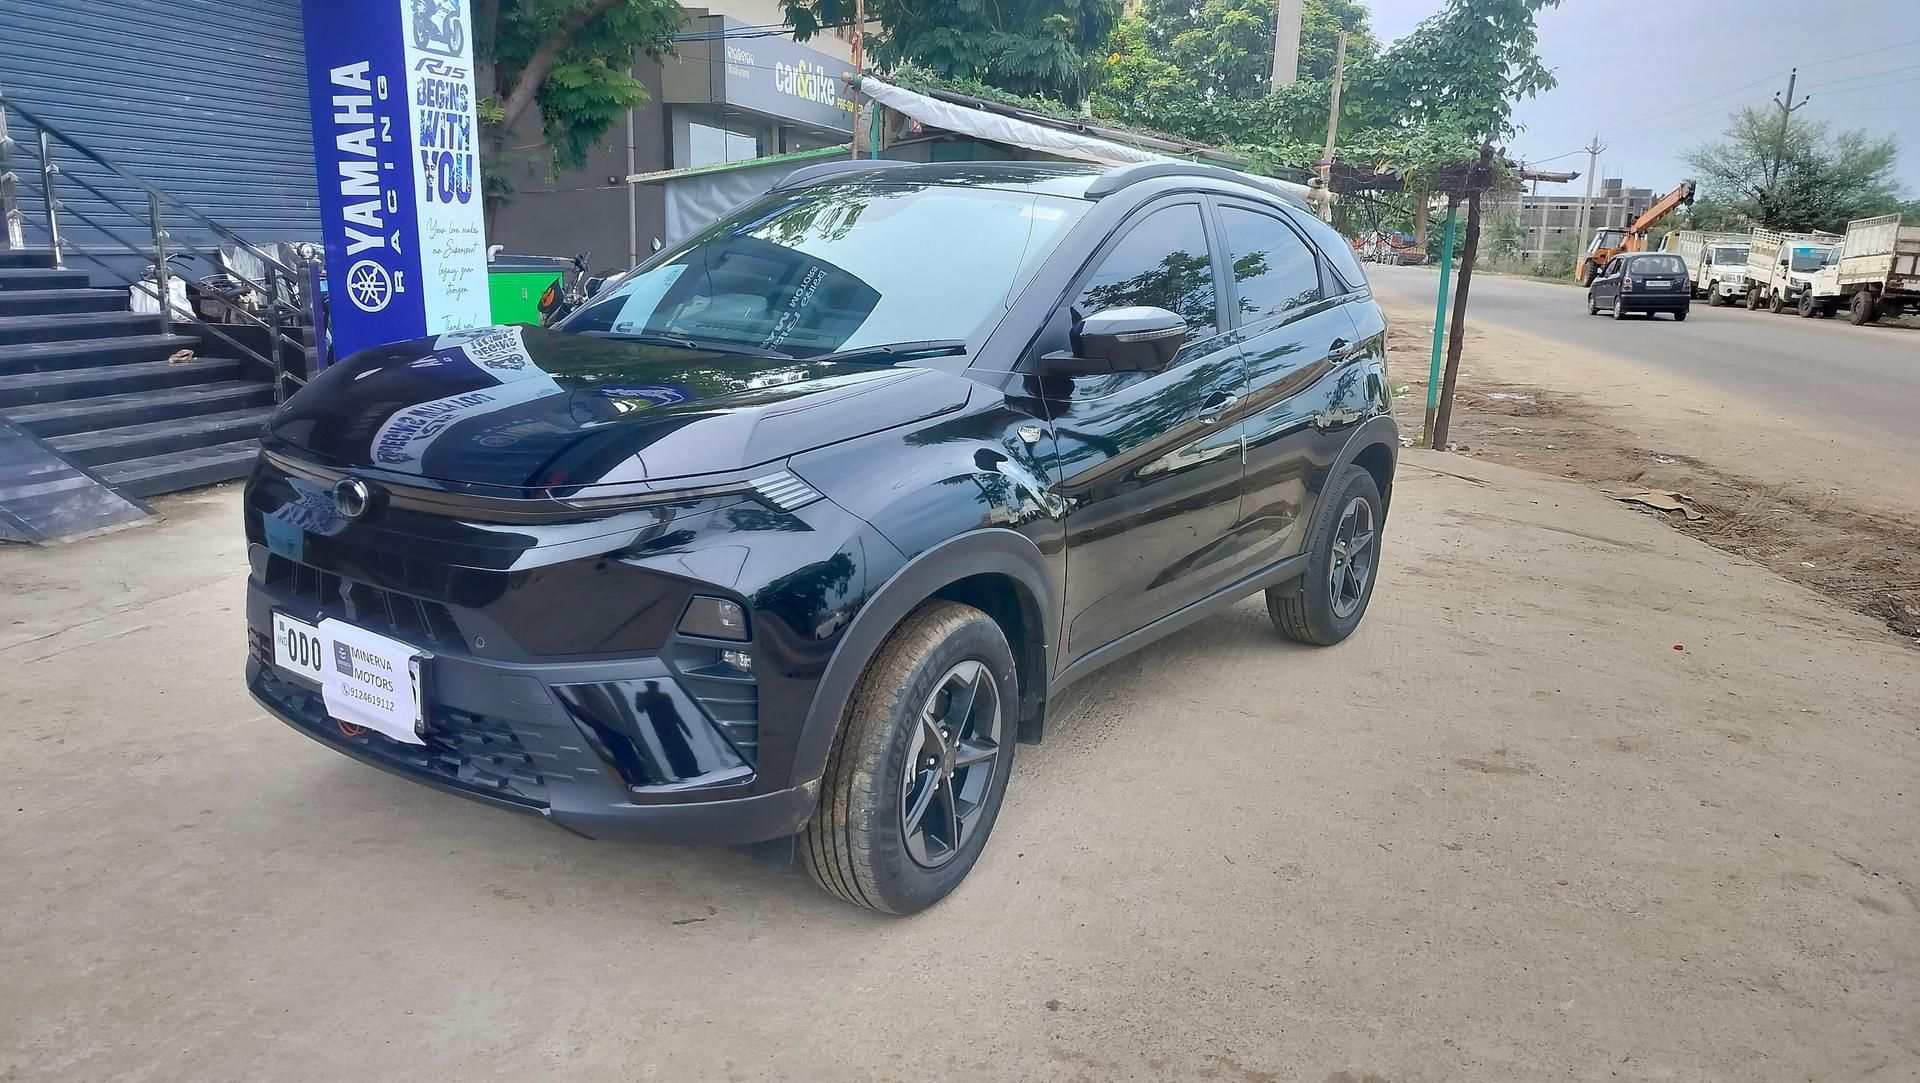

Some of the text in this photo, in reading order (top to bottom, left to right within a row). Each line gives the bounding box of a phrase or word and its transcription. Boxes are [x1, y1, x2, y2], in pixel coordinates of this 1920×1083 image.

[416, 77, 469, 112] BEGINS
[775, 59, 836, 106] car&bike
[836, 97, 864, 115] PRE-OED
[420, 110, 471, 151] WITH
[330, 60, 385, 256] YAMAHA
[377, 74, 405, 293] RACING
[421, 150, 473, 205] YOU
[425, 217, 446, 239] Your
[351, 646, 393, 673] MINERVA
[354, 667, 394, 693] MOTORS
[350, 686, 395, 712] 9124619112
